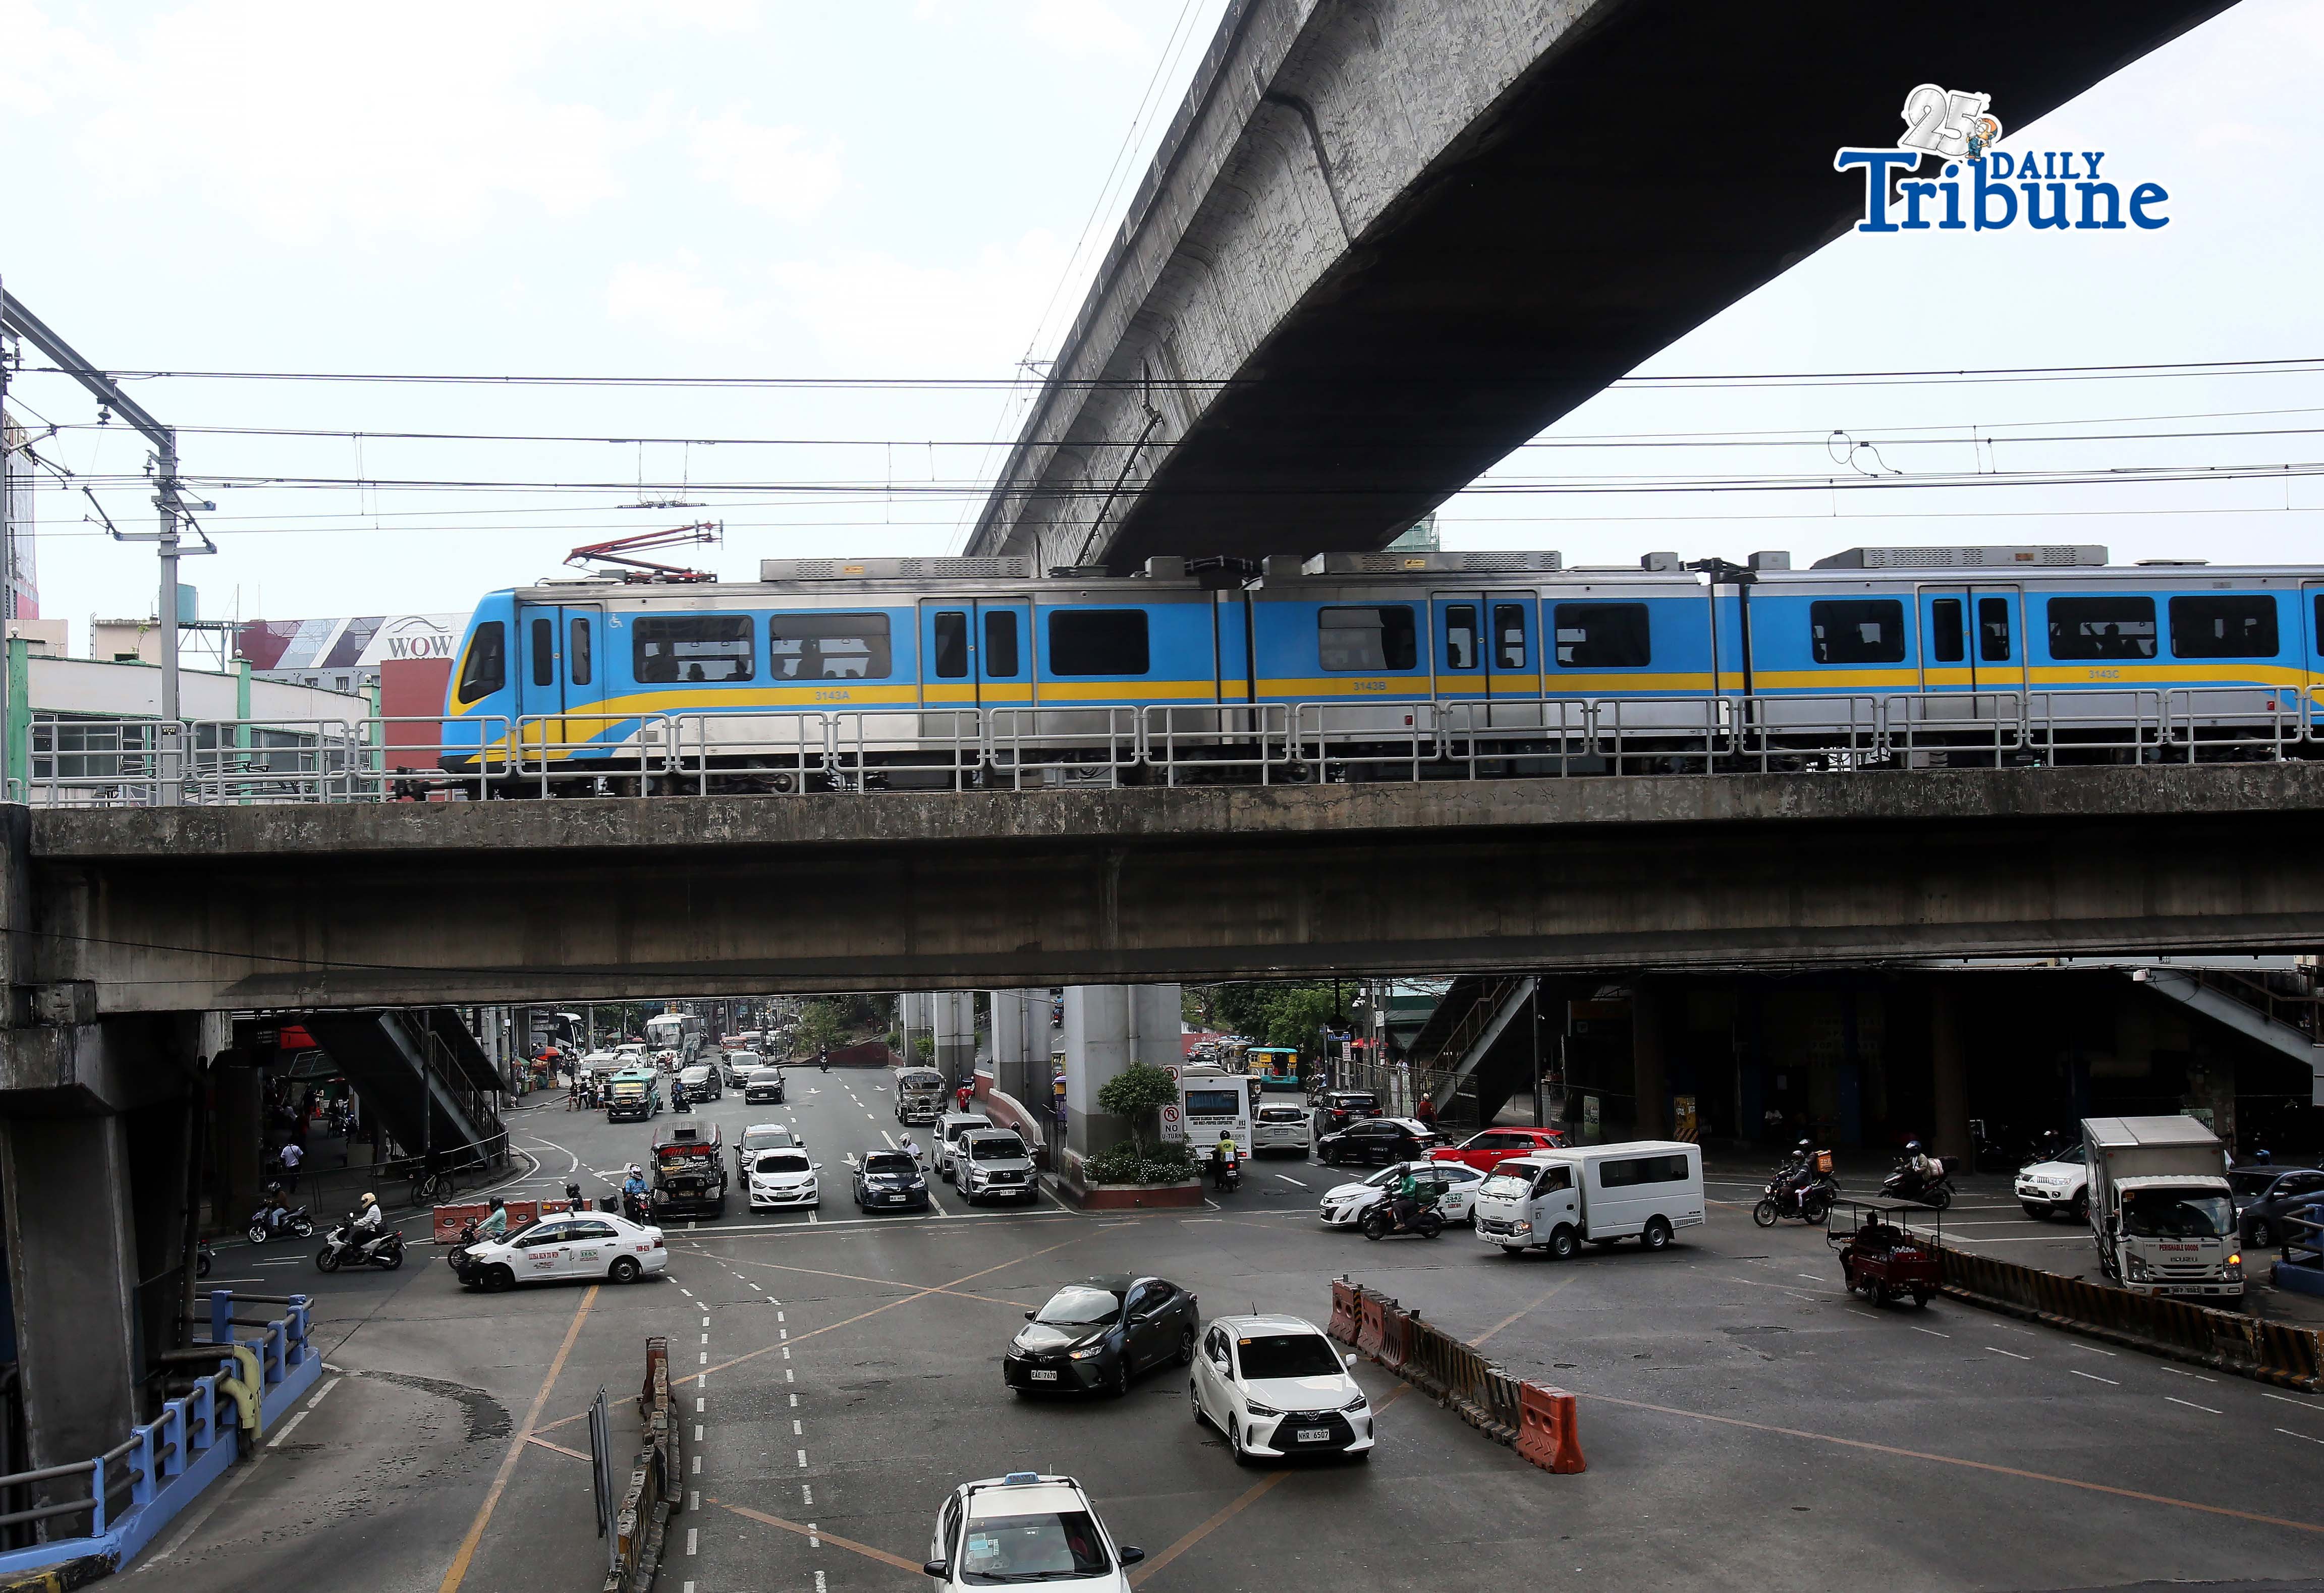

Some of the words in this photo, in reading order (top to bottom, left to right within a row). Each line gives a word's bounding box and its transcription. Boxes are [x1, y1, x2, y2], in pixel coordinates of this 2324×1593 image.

[388, 636, 453, 657] WOW
[2088, 669, 2120, 678] 3143C
[1353, 681, 1387, 691] 3143B
[815, 691, 851, 700] 3143A
